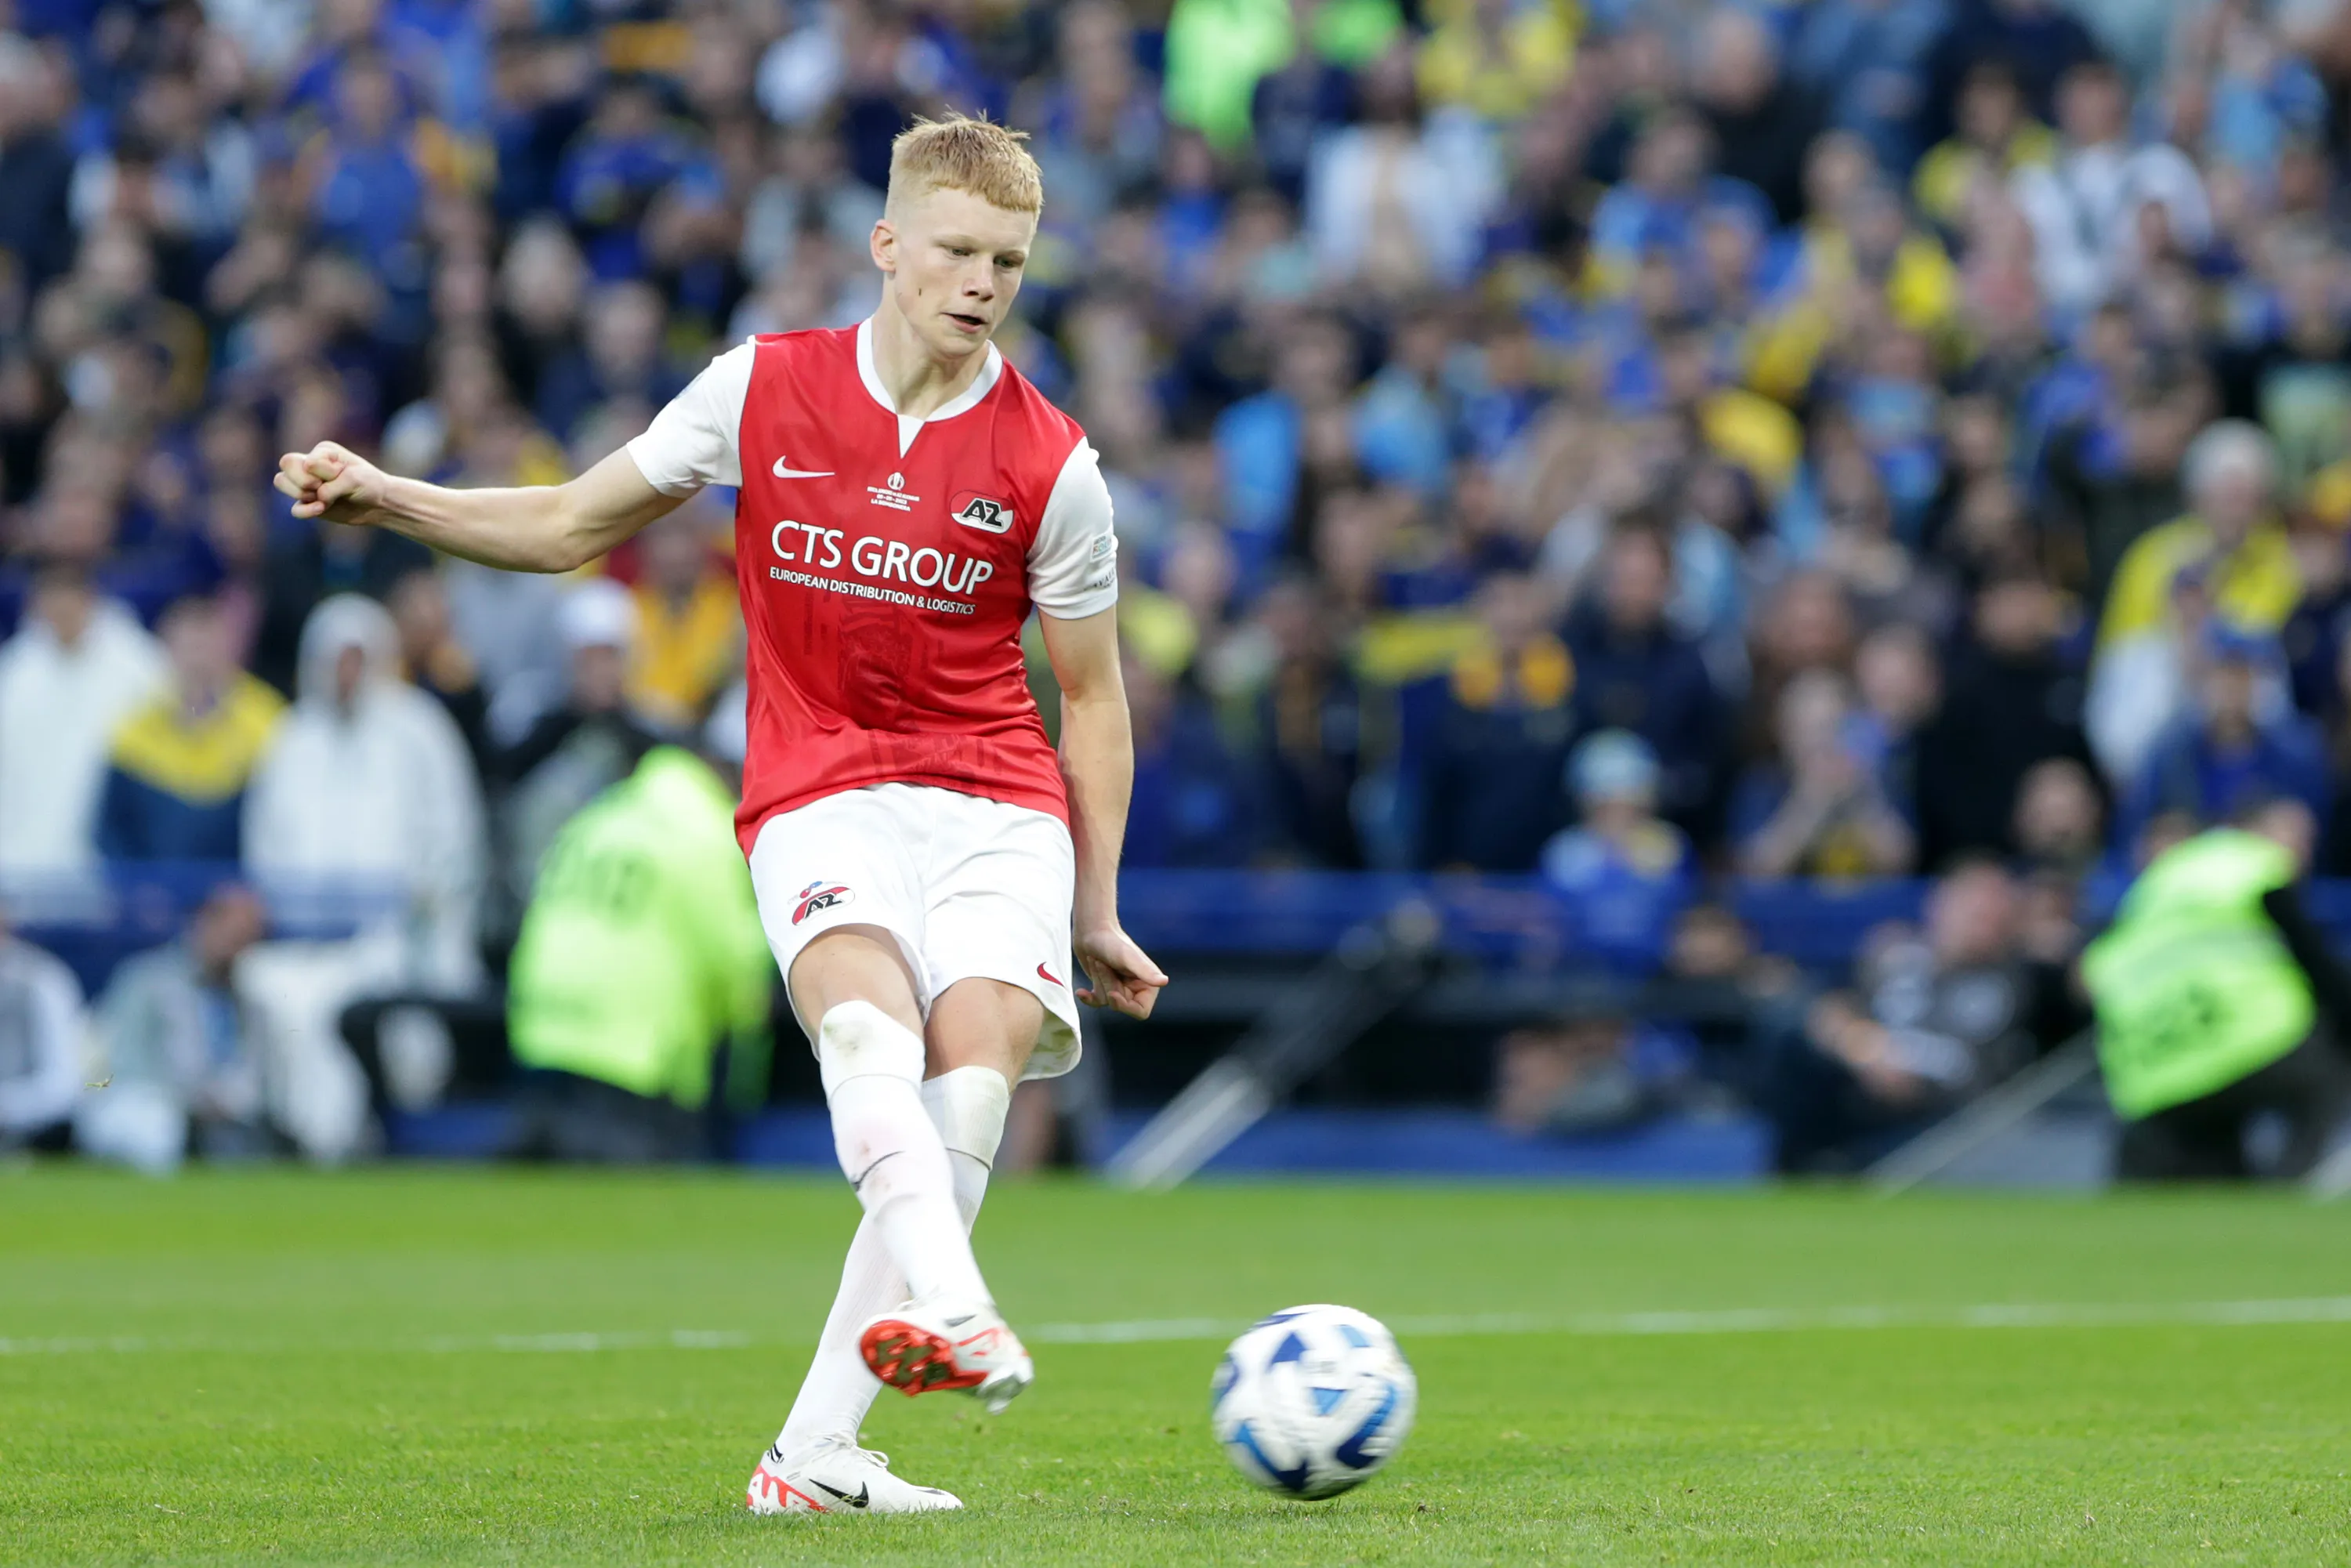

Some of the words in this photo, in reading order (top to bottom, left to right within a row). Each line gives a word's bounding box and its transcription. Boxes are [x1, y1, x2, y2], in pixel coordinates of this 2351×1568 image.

[961, 498, 1003, 527] AZ
[771, 520, 844, 569] CTS
[851, 536, 994, 595] GROUP
[770, 567, 828, 590] EUROPEAN
[830, 580, 915, 607] DISTRIBUTION
[916, 596, 926, 608] &
[926, 597, 976, 615] LOGISTICS
[804, 893, 843, 919] AZ
